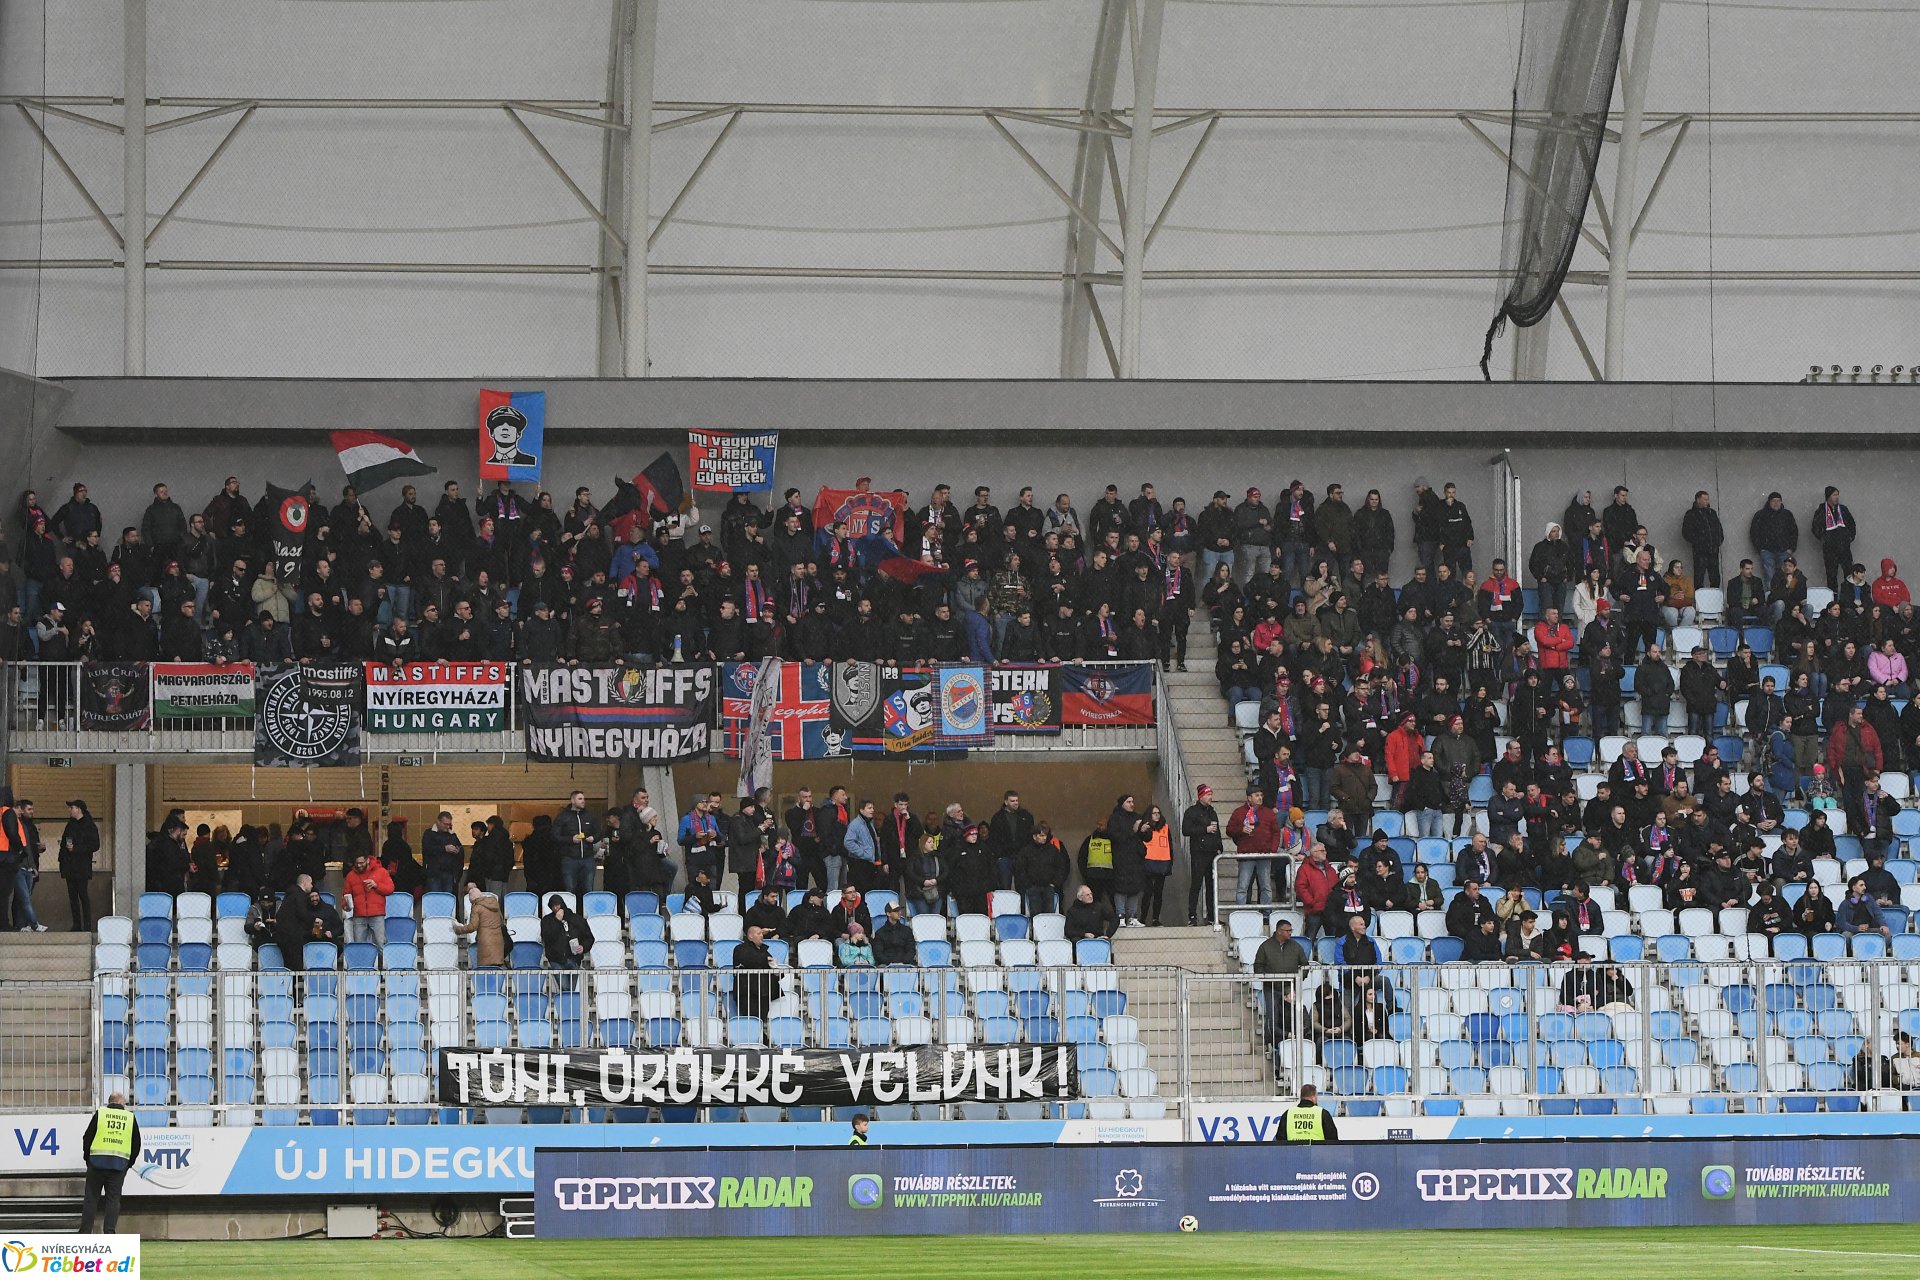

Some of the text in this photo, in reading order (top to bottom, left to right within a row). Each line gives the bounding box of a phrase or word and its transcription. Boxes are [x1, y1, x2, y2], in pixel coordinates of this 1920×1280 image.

[851, 519, 880, 534] NY S
[157, 671, 251, 686] MAGYARORSZÁG
[303, 666, 358, 680] mastiffs
[373, 665, 500, 682] MASTIFFS
[308, 688, 354, 699] 1995.08.12
[859, 663, 871, 707] NYSFC
[170, 692, 240, 706] PETNEHÁZA
[373, 688, 499, 706] NYÍREGYHÁZA
[282, 716, 335, 741] SINCE 1995
[374, 712, 498, 729] HUNGARY
[529, 723, 707, 759] NYÍREGYHÁZA
[296, 746, 318, 755] 1928
[107, 1120, 126, 1131] 1331
[1198, 1116, 1240, 1142] V3
[1294, 1121, 1314, 1130] 1206
[14, 1127, 60, 1156] V4
[144, 1148, 192, 1170] MTK
[275, 1139, 327, 1181] ÚJ
[1745, 1164, 1866, 1182] TOVÁBBI RÉSZLETEK:
[894, 1173, 1017, 1191] TOVÁBBI RÉSZLETEK:
[1359, 1180, 1372, 1193] 18
[1576, 1167, 1668, 1199] RADAR
[1745, 1183, 1890, 1198] WWW.TIPPMIX.HU/RADAR
[718, 1176, 814, 1208] RADAR
[894, 1192, 1042, 1208] WWW.TIPPMIX.HU/RADAR
